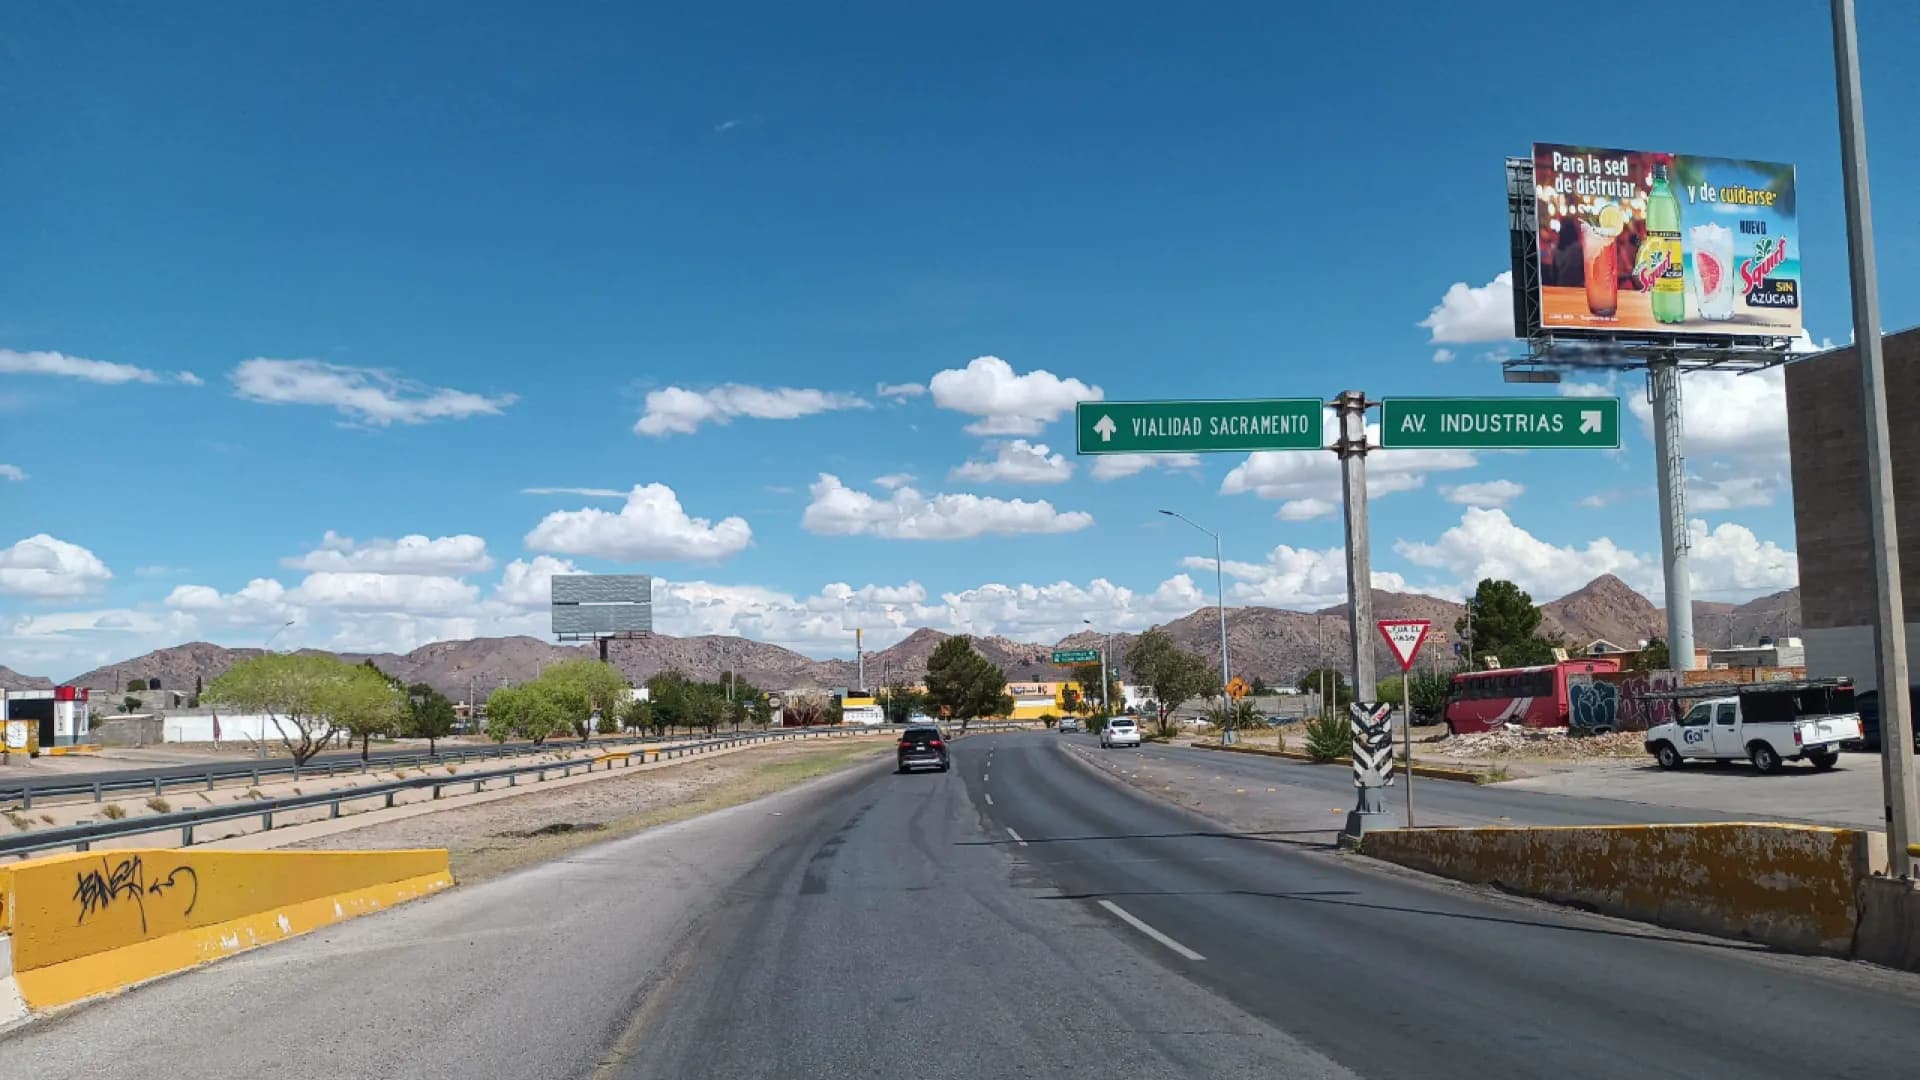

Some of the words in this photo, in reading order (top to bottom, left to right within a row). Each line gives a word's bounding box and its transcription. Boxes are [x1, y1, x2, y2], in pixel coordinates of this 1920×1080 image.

[1553, 151, 1585, 174] Para
[1588, 154, 1602, 174] la
[1604, 156, 1629, 177] sed
[1555, 173, 1573, 193] de
[1576, 175, 1636, 198] disfrutar
[1688, 185, 1696, 204] y
[1700, 182, 1717, 202] de
[1740, 220, 1767, 235] NUEVO
[1739, 236, 1787, 297] Squirt
[1775, 281, 1794, 292] SIN
[1750, 291, 1795, 305] AZÚCAR
[1132, 417, 1202, 436] VIALIDAD
[1210, 415, 1308, 435] SACRAMENTO
[1401, 414, 1426, 433] AV.
[1441, 413, 1565, 433] INDUSTRIAS
